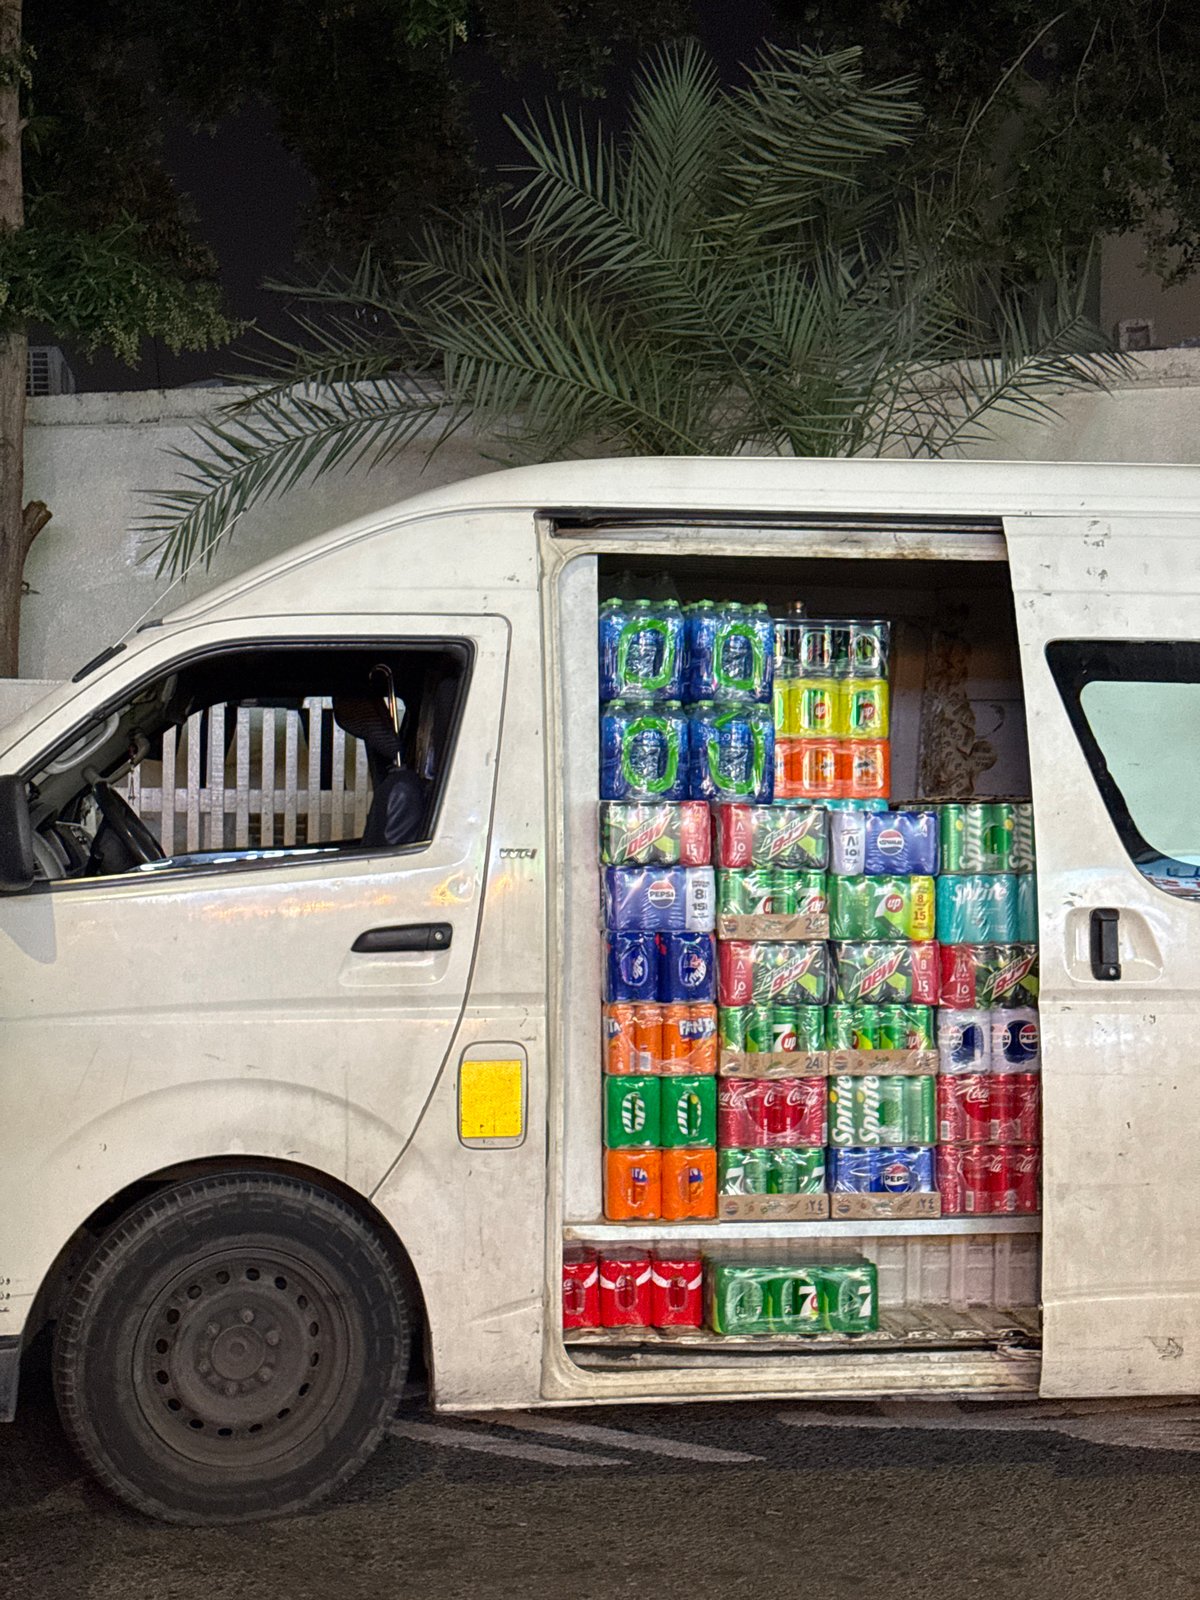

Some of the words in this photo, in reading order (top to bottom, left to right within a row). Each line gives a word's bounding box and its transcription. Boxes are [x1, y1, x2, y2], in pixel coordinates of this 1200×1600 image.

[686, 844, 697, 857] 15
[649, 890, 674, 898] PEPSI
[694, 889, 704, 899] 8
[917, 895, 924, 903] 8
[691, 903, 706, 911] 15
[914, 911, 926, 921] 15
[921, 960, 927, 970] 8
[918, 980, 929, 992] 15
[679, 1017, 716, 1036] FANTA
[805, 1057, 820, 1069] 24
[832, 1075, 855, 1146] Sprite
[859, 1075, 882, 1145] Sprite
